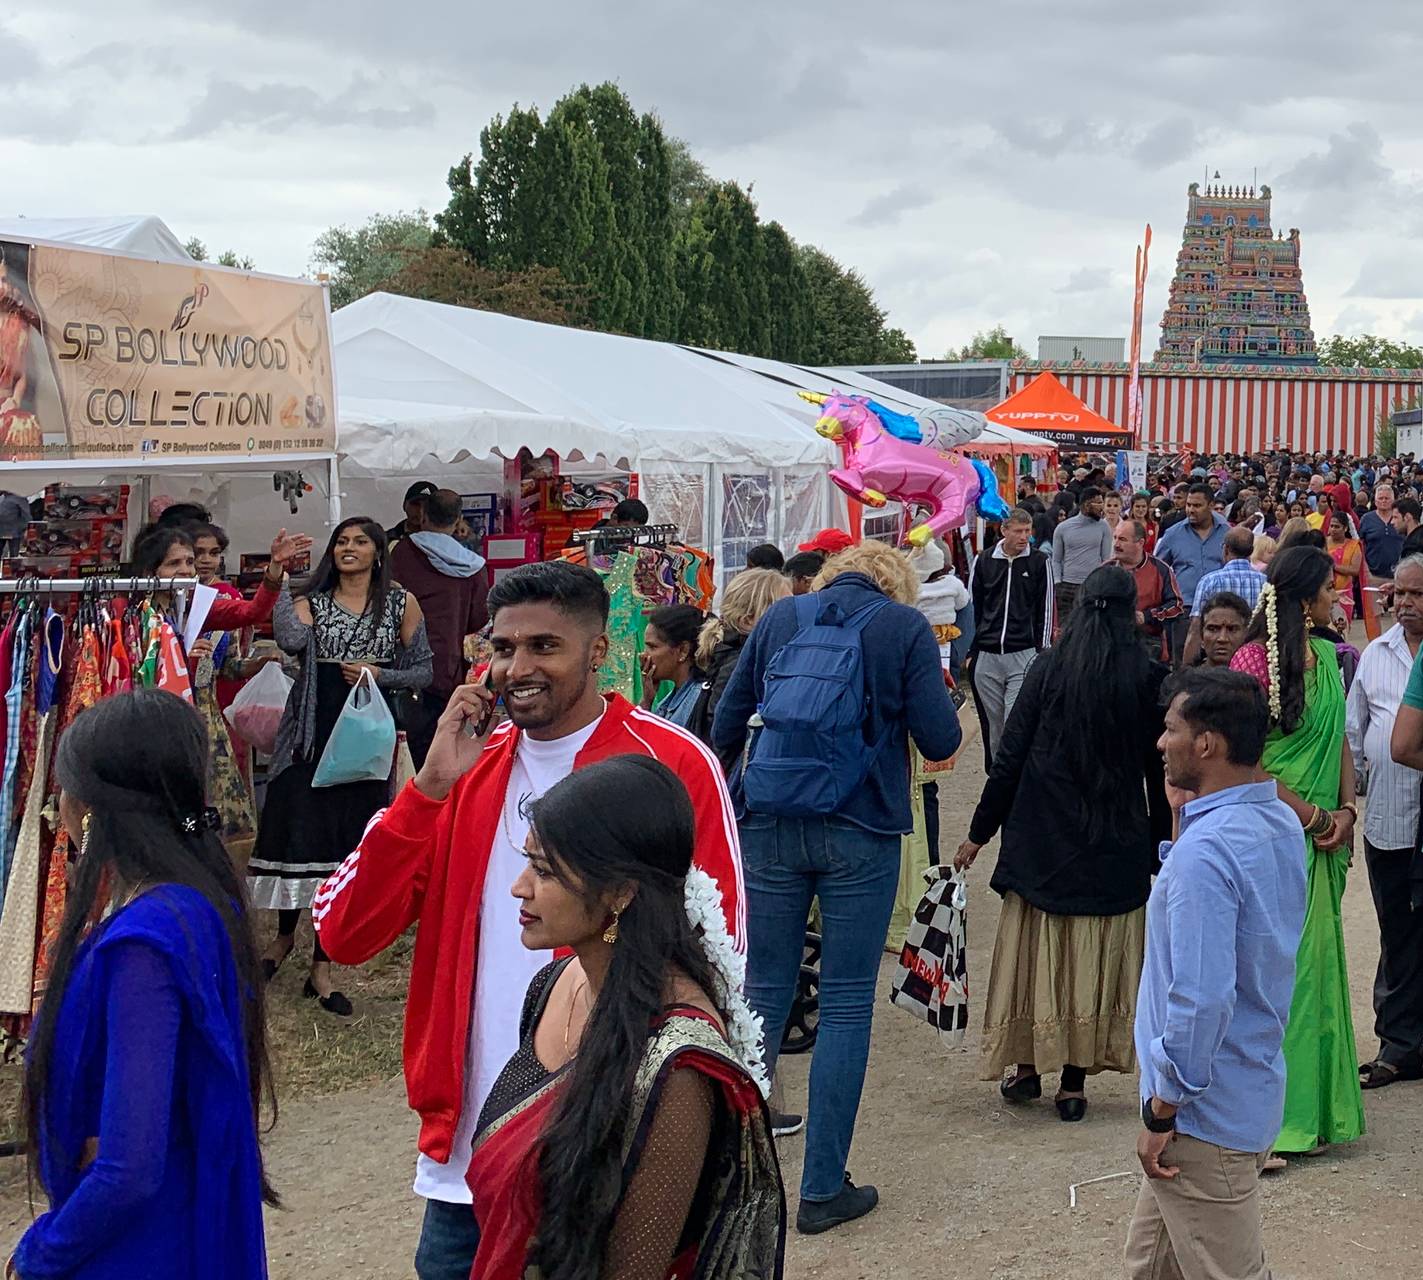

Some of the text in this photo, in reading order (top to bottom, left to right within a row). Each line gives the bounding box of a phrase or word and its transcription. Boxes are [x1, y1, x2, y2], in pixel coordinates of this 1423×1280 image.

[59, 322, 288, 370] SP BOLLYWOOD
[161, 440, 241, 454] SP Bollywood Collection
